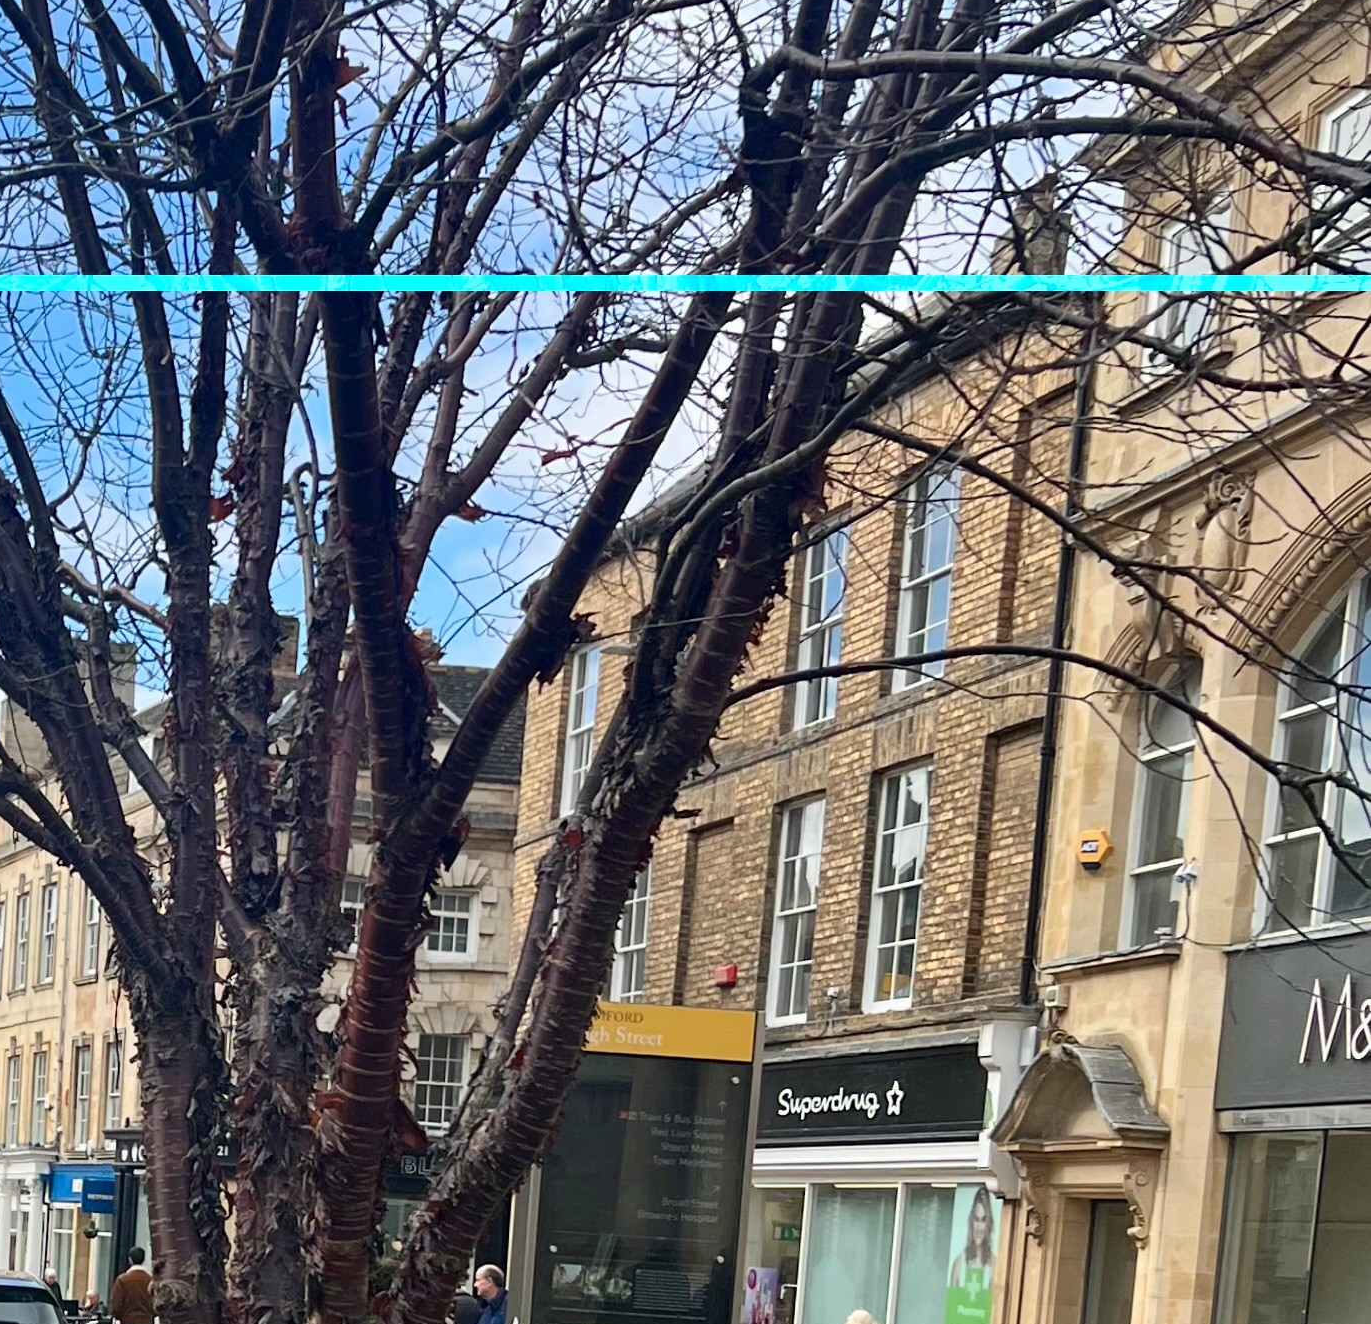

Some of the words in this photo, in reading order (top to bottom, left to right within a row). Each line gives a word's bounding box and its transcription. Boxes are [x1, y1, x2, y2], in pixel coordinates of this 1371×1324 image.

[615, 1025, 663, 1046] Street
[778, 1087, 880, 1120] Superdrug
[640, 1111, 661, 1122] Train
[673, 1114, 691, 1124] Bus
[693, 1115, 726, 1125] Station
[651, 1126, 669, 1137] Red
[670, 1128, 692, 1138] Lion
[693, 1129, 725, 1141] Square
[661, 1141, 689, 1153] Sheep
[691, 1143, 724, 1154] Market
[653, 1155, 676, 1166] Town
[661, 1196, 689, 1207] Broad
[691, 1198, 719, 1209] Street
[680, 1212, 719, 1224] Hospital
